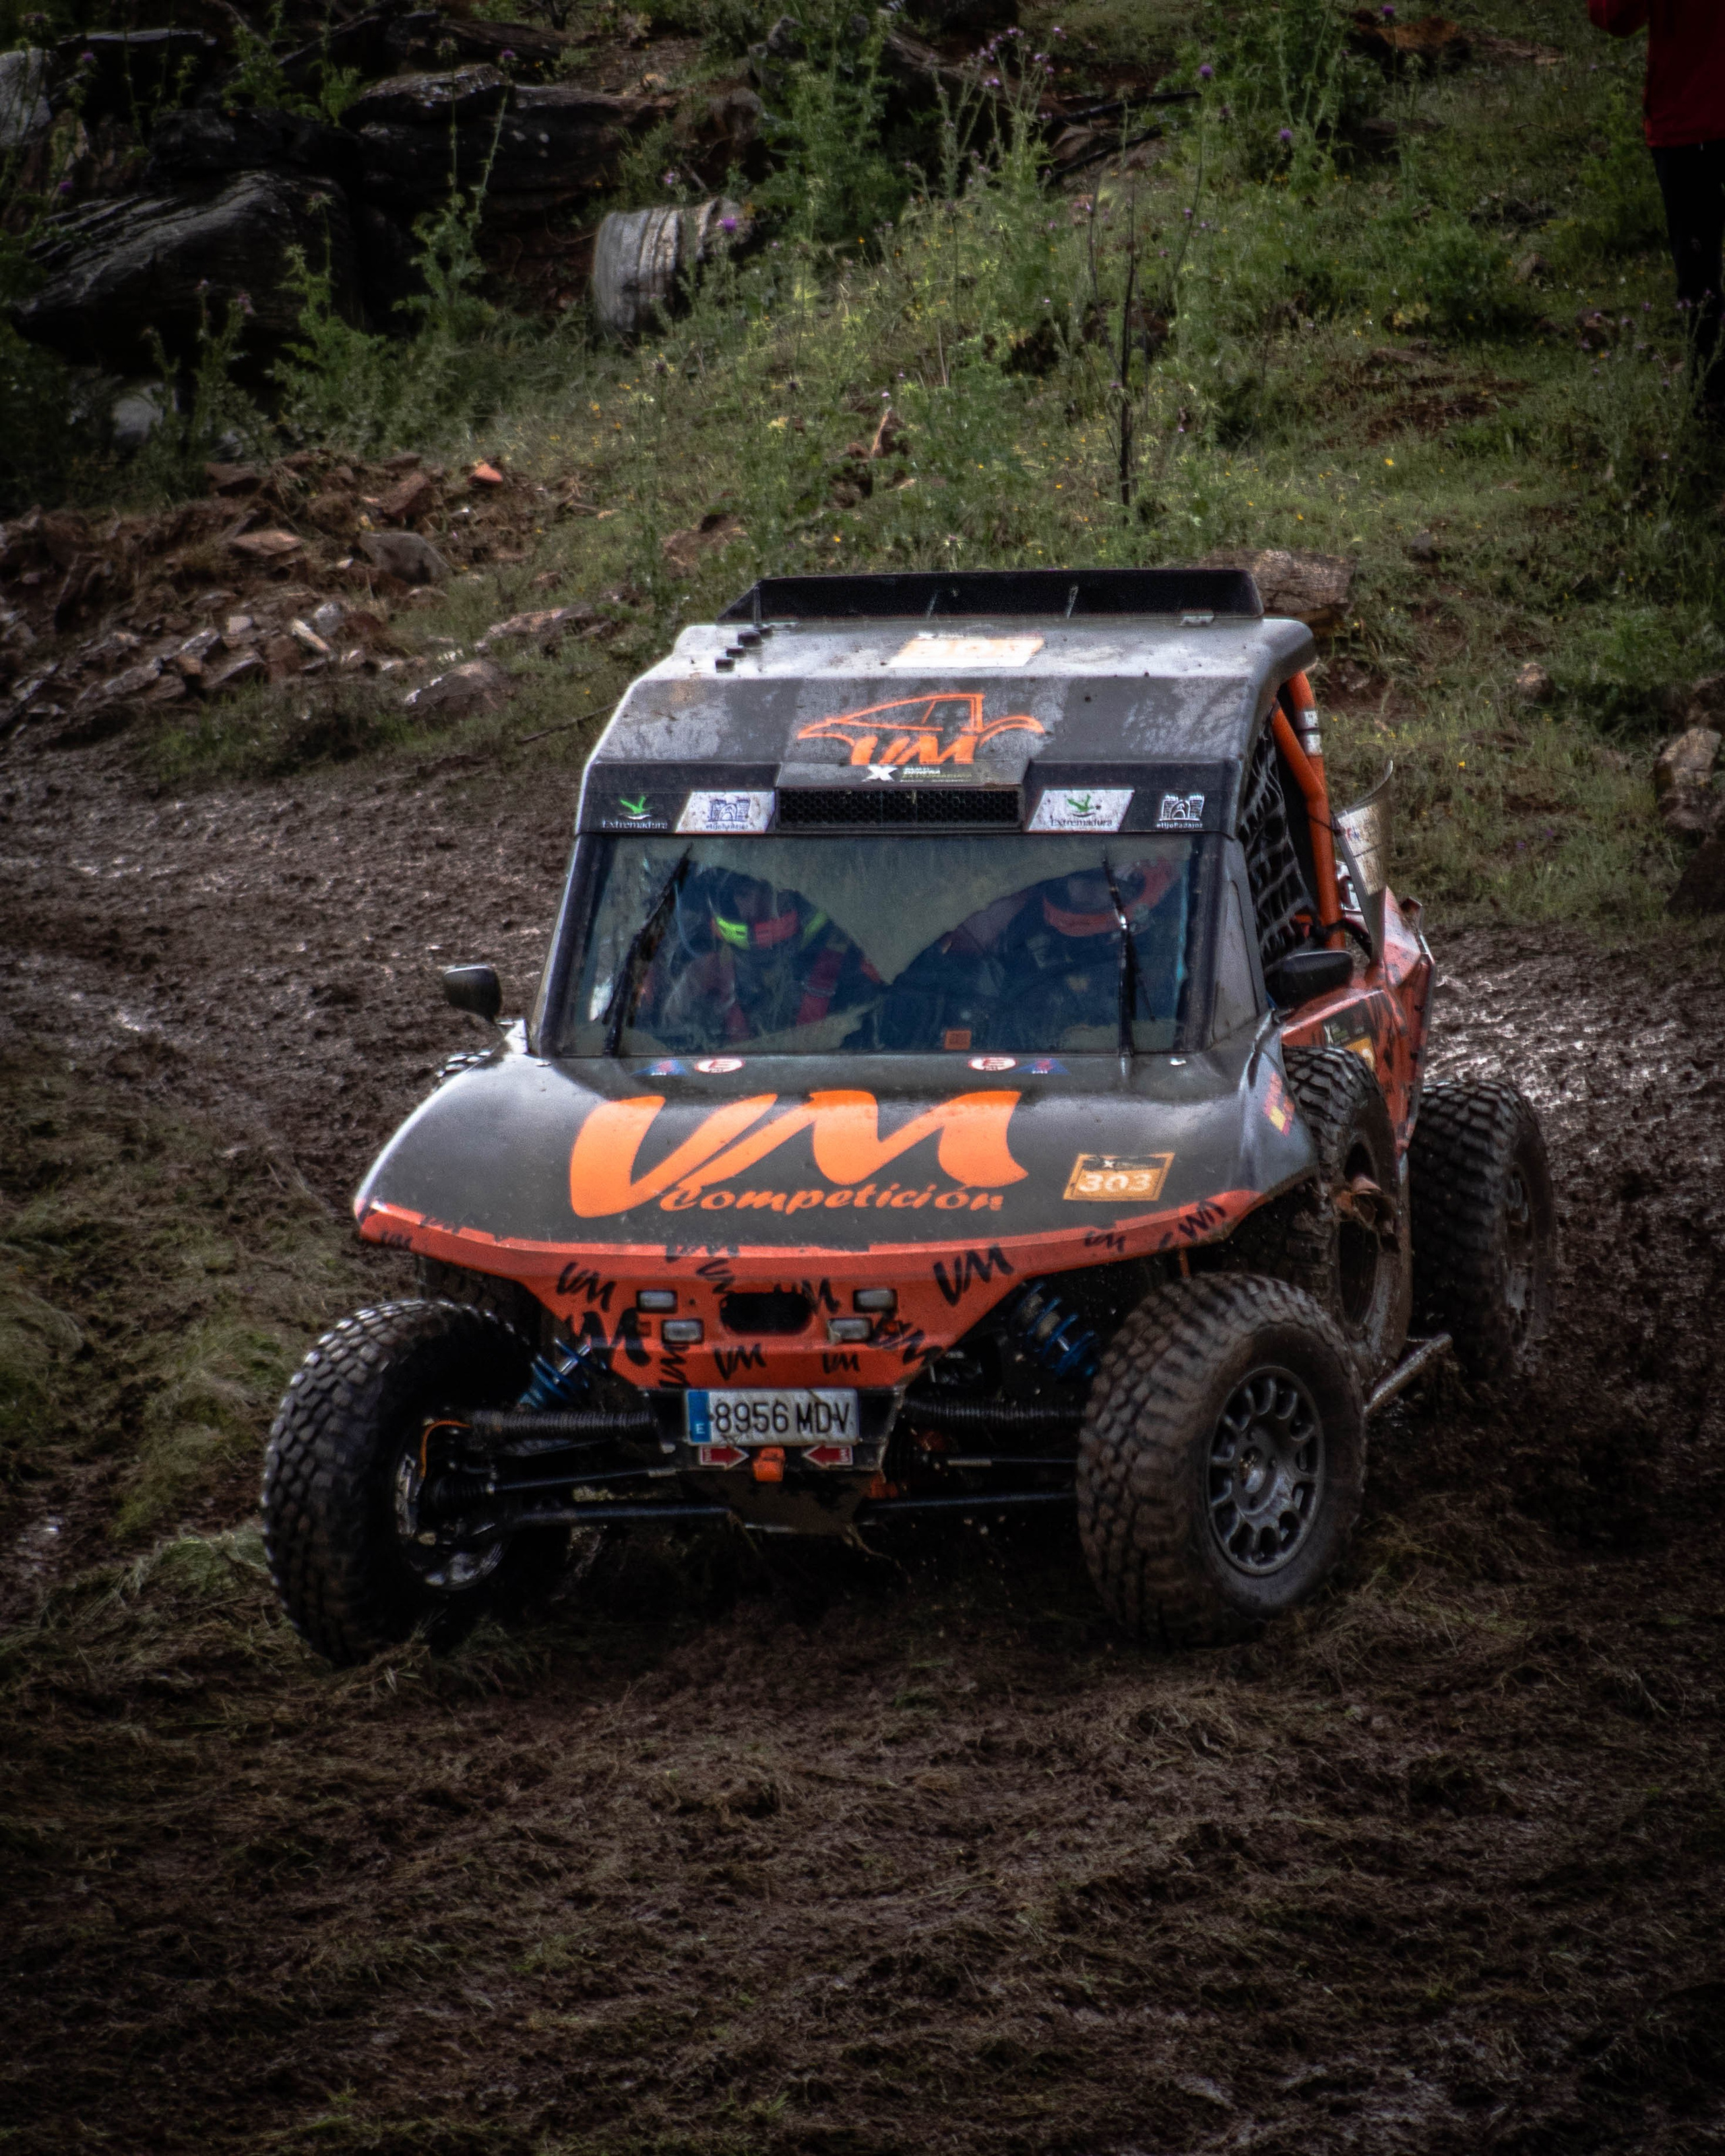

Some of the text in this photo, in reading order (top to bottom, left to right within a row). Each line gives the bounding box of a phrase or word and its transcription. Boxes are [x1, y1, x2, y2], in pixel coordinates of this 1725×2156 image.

[1049, 819, 1112, 828] Extremadura
[1078, 1173, 1152, 1193] 303
[660, 1182, 1005, 1215] Competición
[933, 1244, 1014, 1306] VM
[714, 1343, 766, 1381] VM
[821, 1352, 860, 1374] VM
[695, 1422, 705, 1435] E
[715, 1401, 850, 1434] 8956 MDV
